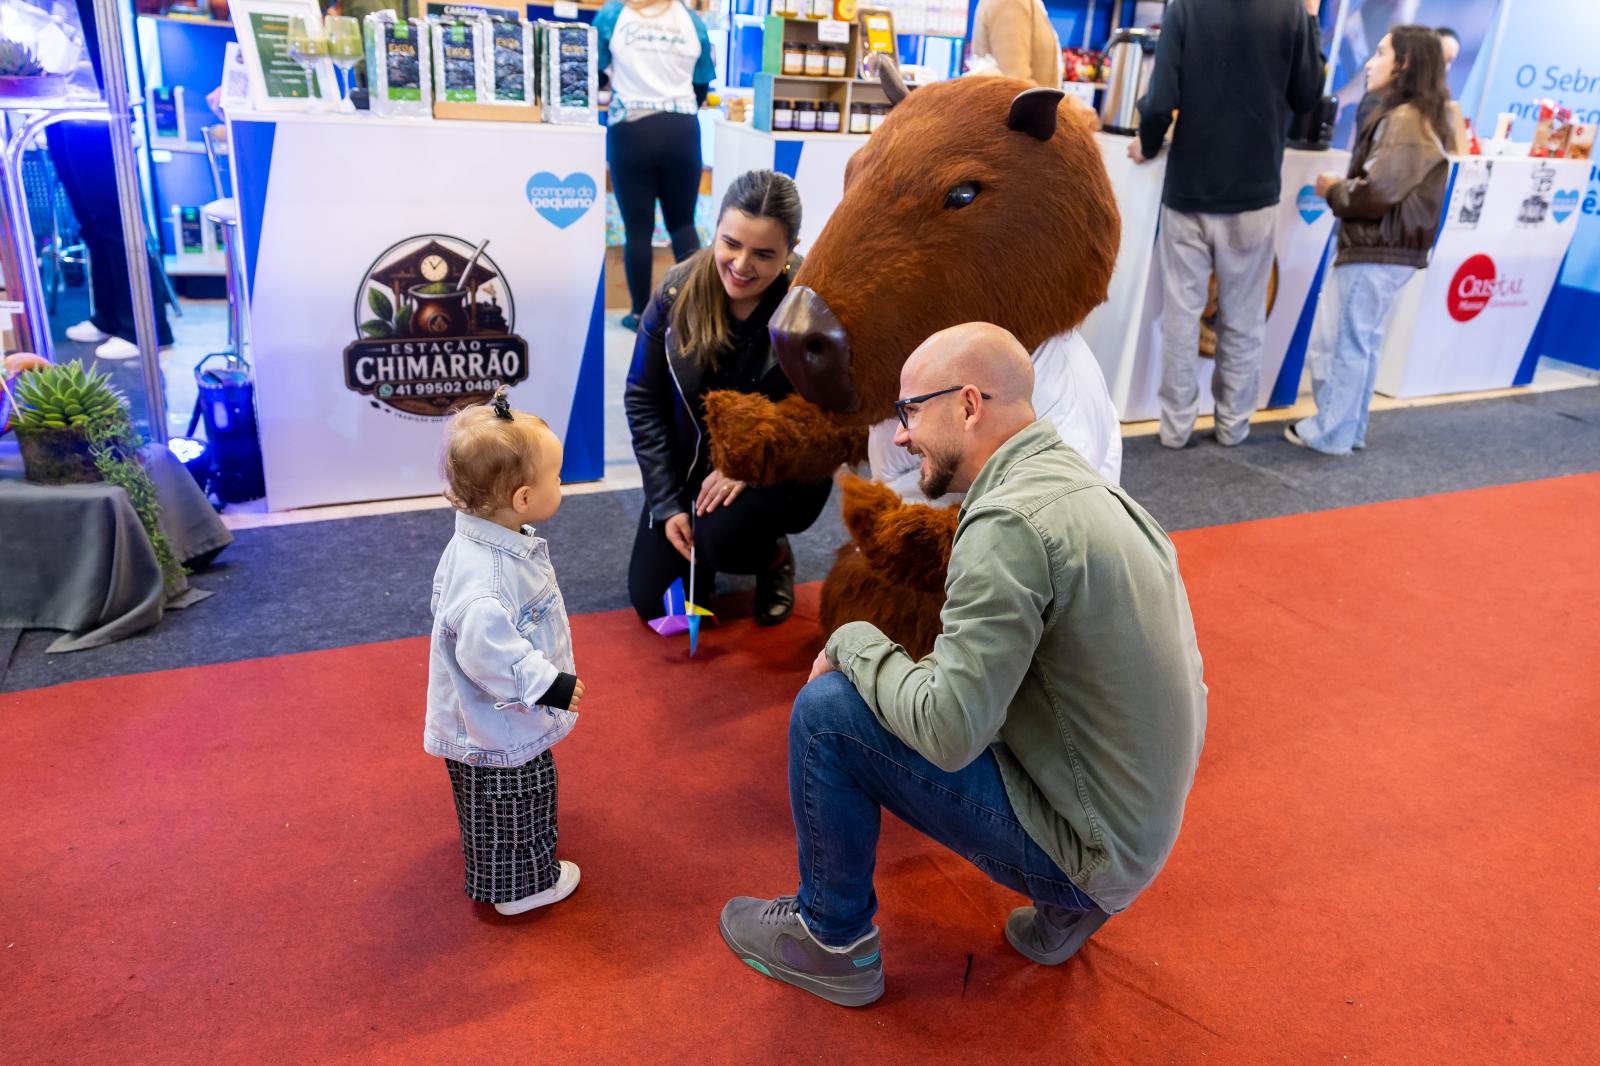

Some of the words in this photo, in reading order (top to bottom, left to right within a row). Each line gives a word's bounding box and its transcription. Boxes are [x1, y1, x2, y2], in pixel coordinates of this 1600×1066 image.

[1516, 64, 1537, 89] O
[531, 187, 576, 199] compre
[577, 185, 593, 198] do
[532, 197, 593, 211] pequeno
[391, 340, 481, 354] ESTAÇÃO
[355, 350, 520, 385] CHIMARRÃO
[395, 384, 412, 395] 41
[415, 382, 462, 395] 99502
[466, 379, 500, 392] 0489
